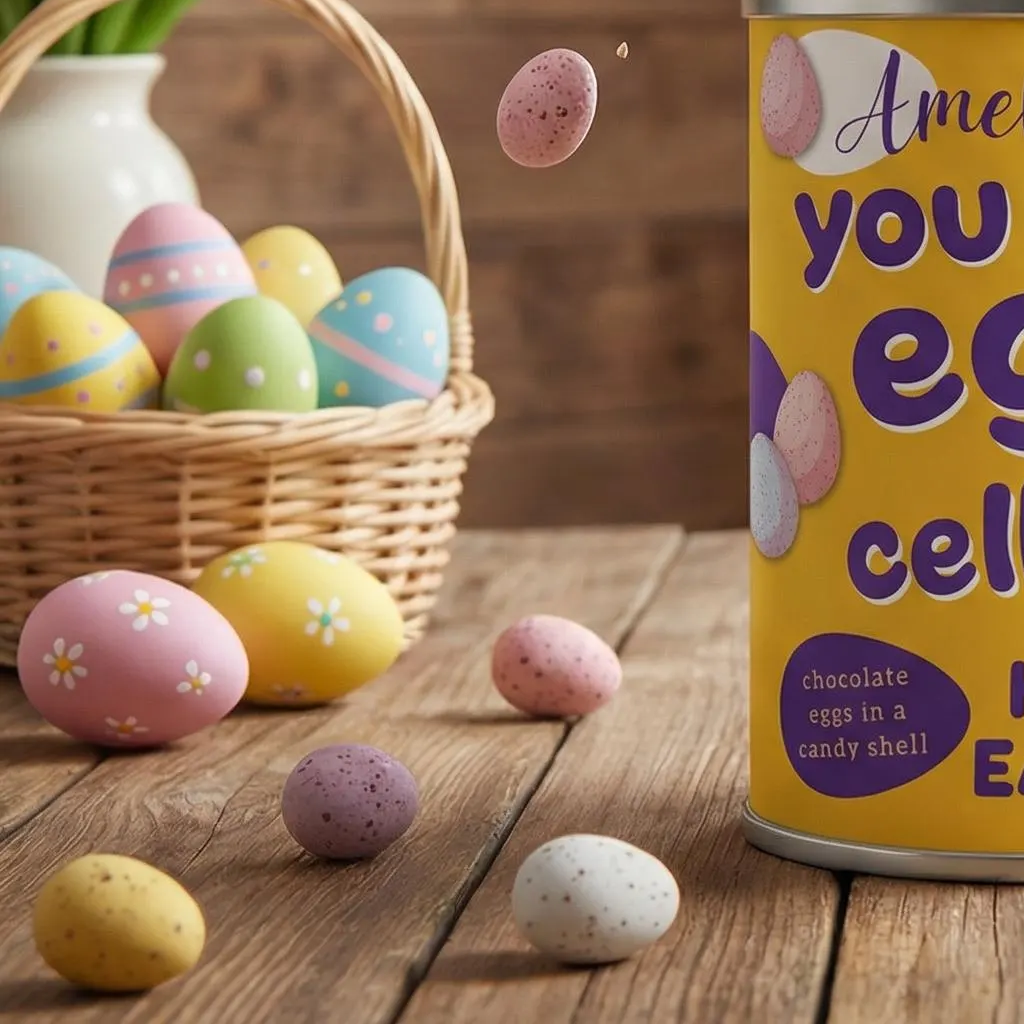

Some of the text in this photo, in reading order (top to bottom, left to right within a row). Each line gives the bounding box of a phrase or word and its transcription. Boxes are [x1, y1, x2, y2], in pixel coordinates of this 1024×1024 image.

[794, 180, 1009, 291] you
[802, 666, 909, 690] chocolate
[809, 701, 906, 728] eggs in a
[799, 732, 928, 761] candy shell
